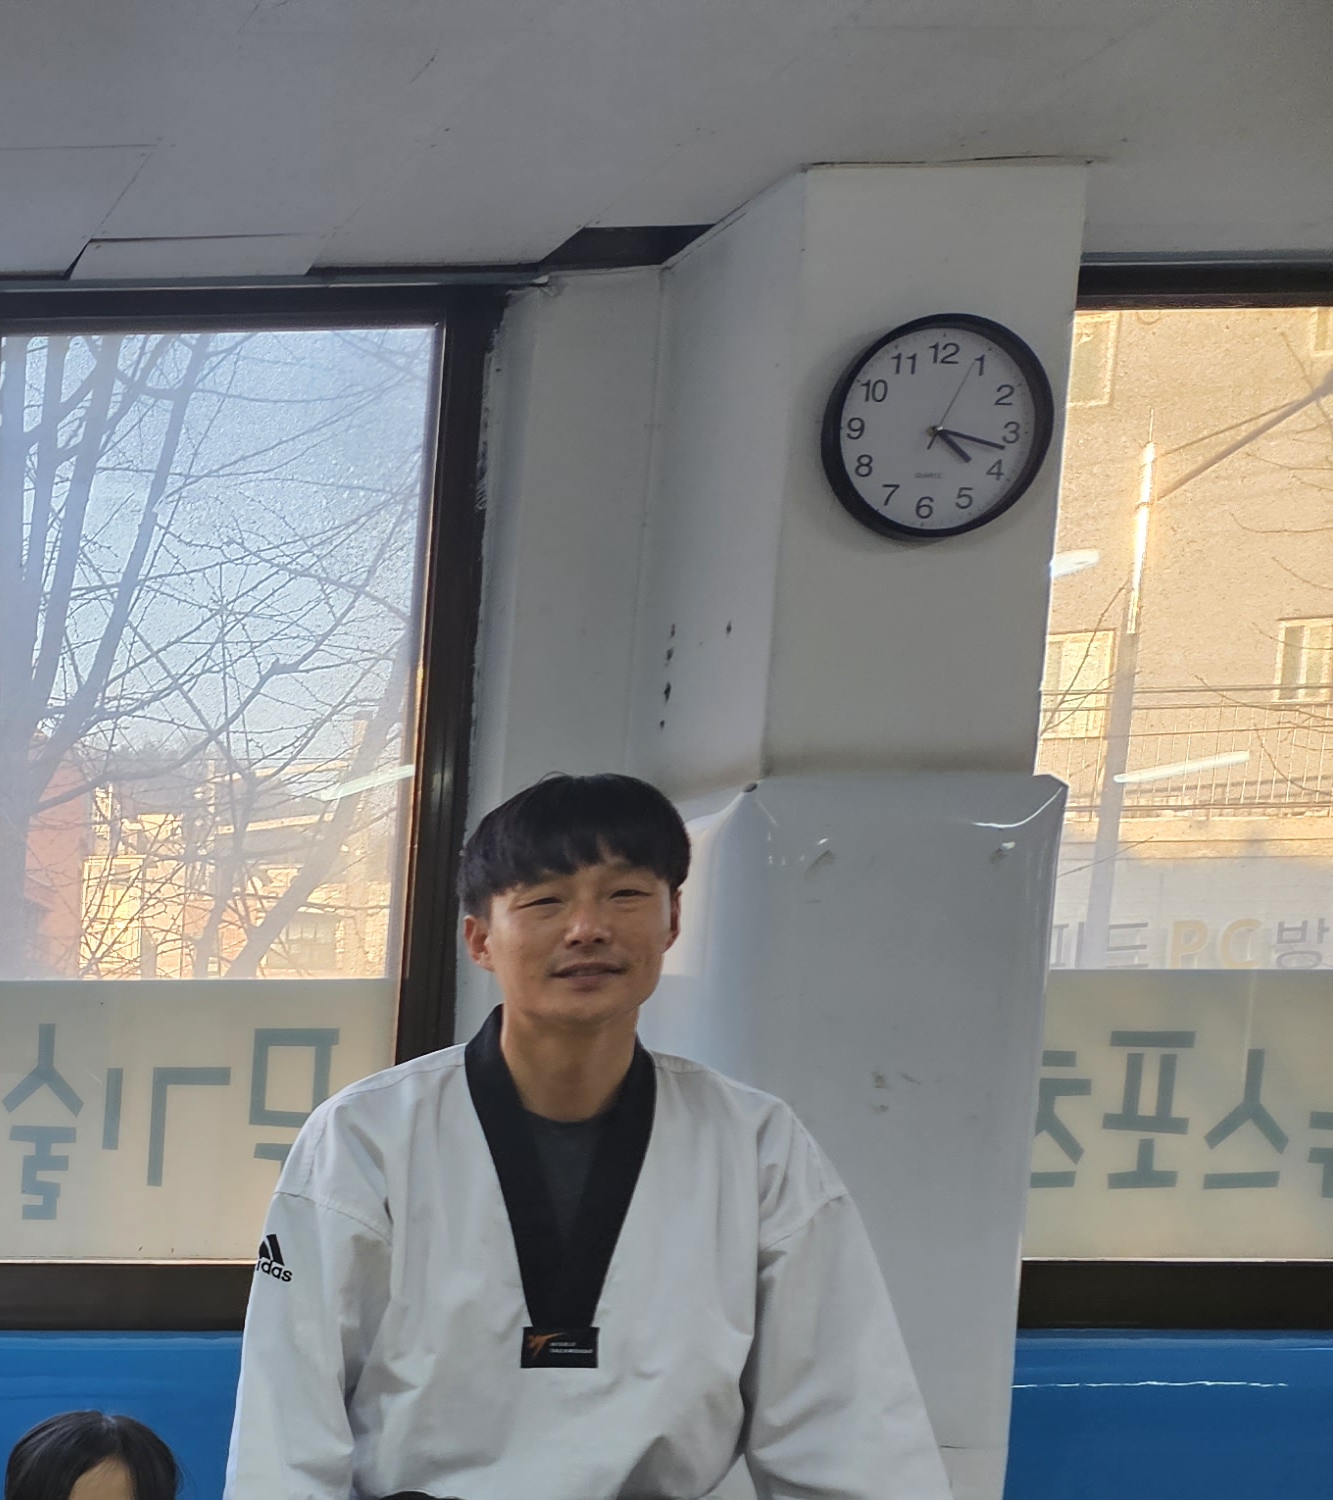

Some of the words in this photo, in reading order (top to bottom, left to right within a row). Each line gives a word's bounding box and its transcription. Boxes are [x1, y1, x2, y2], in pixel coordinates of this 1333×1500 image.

[891, 353, 918, 375] 11
[929, 342, 960, 364] 12
[974, 354, 986, 376] 1
[861, 379, 888, 402] 10
[994, 384, 1015, 406] 2
[846, 417, 865, 439] 9
[1002, 421, 1020, 444] 3
[855, 454, 873, 477] 8
[986, 459, 1004, 481] 4
[882, 484, 900, 506] 7
[955, 487, 974, 509] 5
[915, 496, 933, 519] 6
